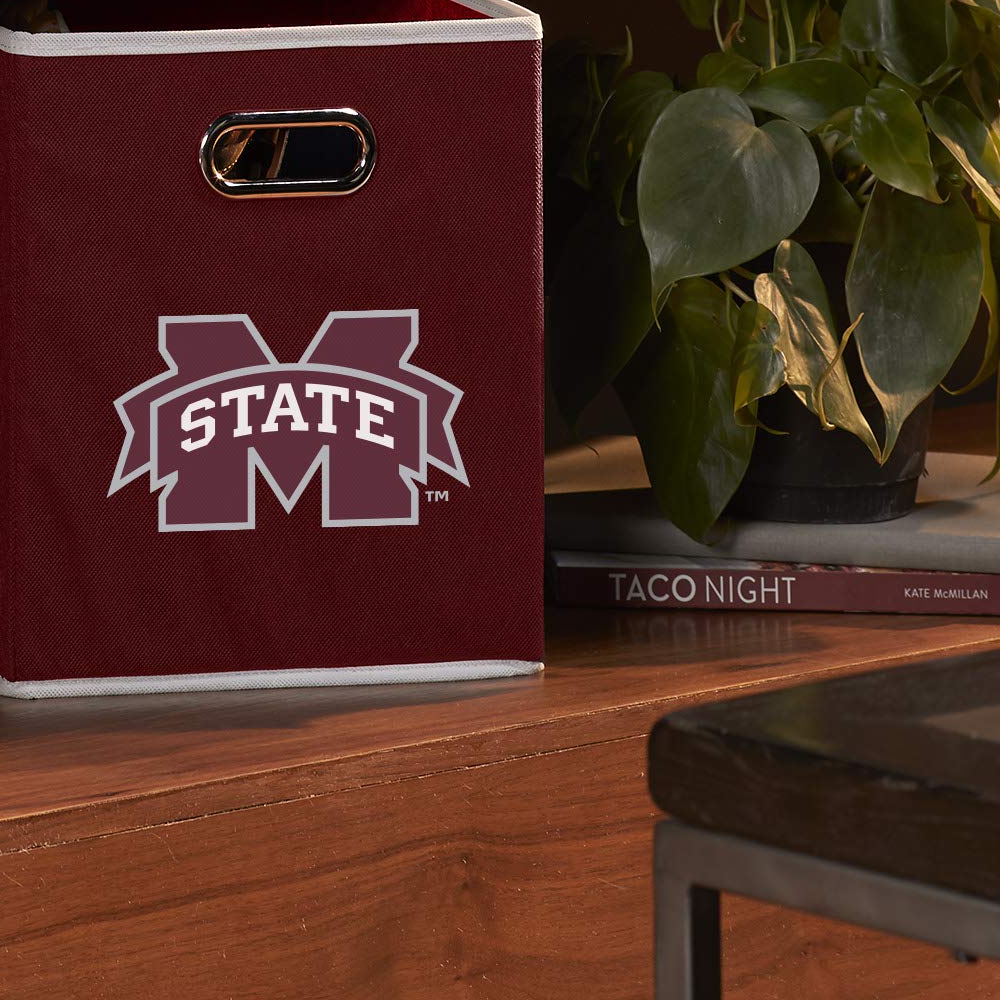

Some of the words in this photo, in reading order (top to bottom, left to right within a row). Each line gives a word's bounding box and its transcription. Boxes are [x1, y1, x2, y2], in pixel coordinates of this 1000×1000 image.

[181, 383, 394, 452] STATE
[425, 490, 449, 502] TM
[609, 573, 696, 602] TACO
[706, 576, 796, 604] NIGHT
[904, 588, 930, 599] KATE
[933, 588, 988, 600] McMILLAN
